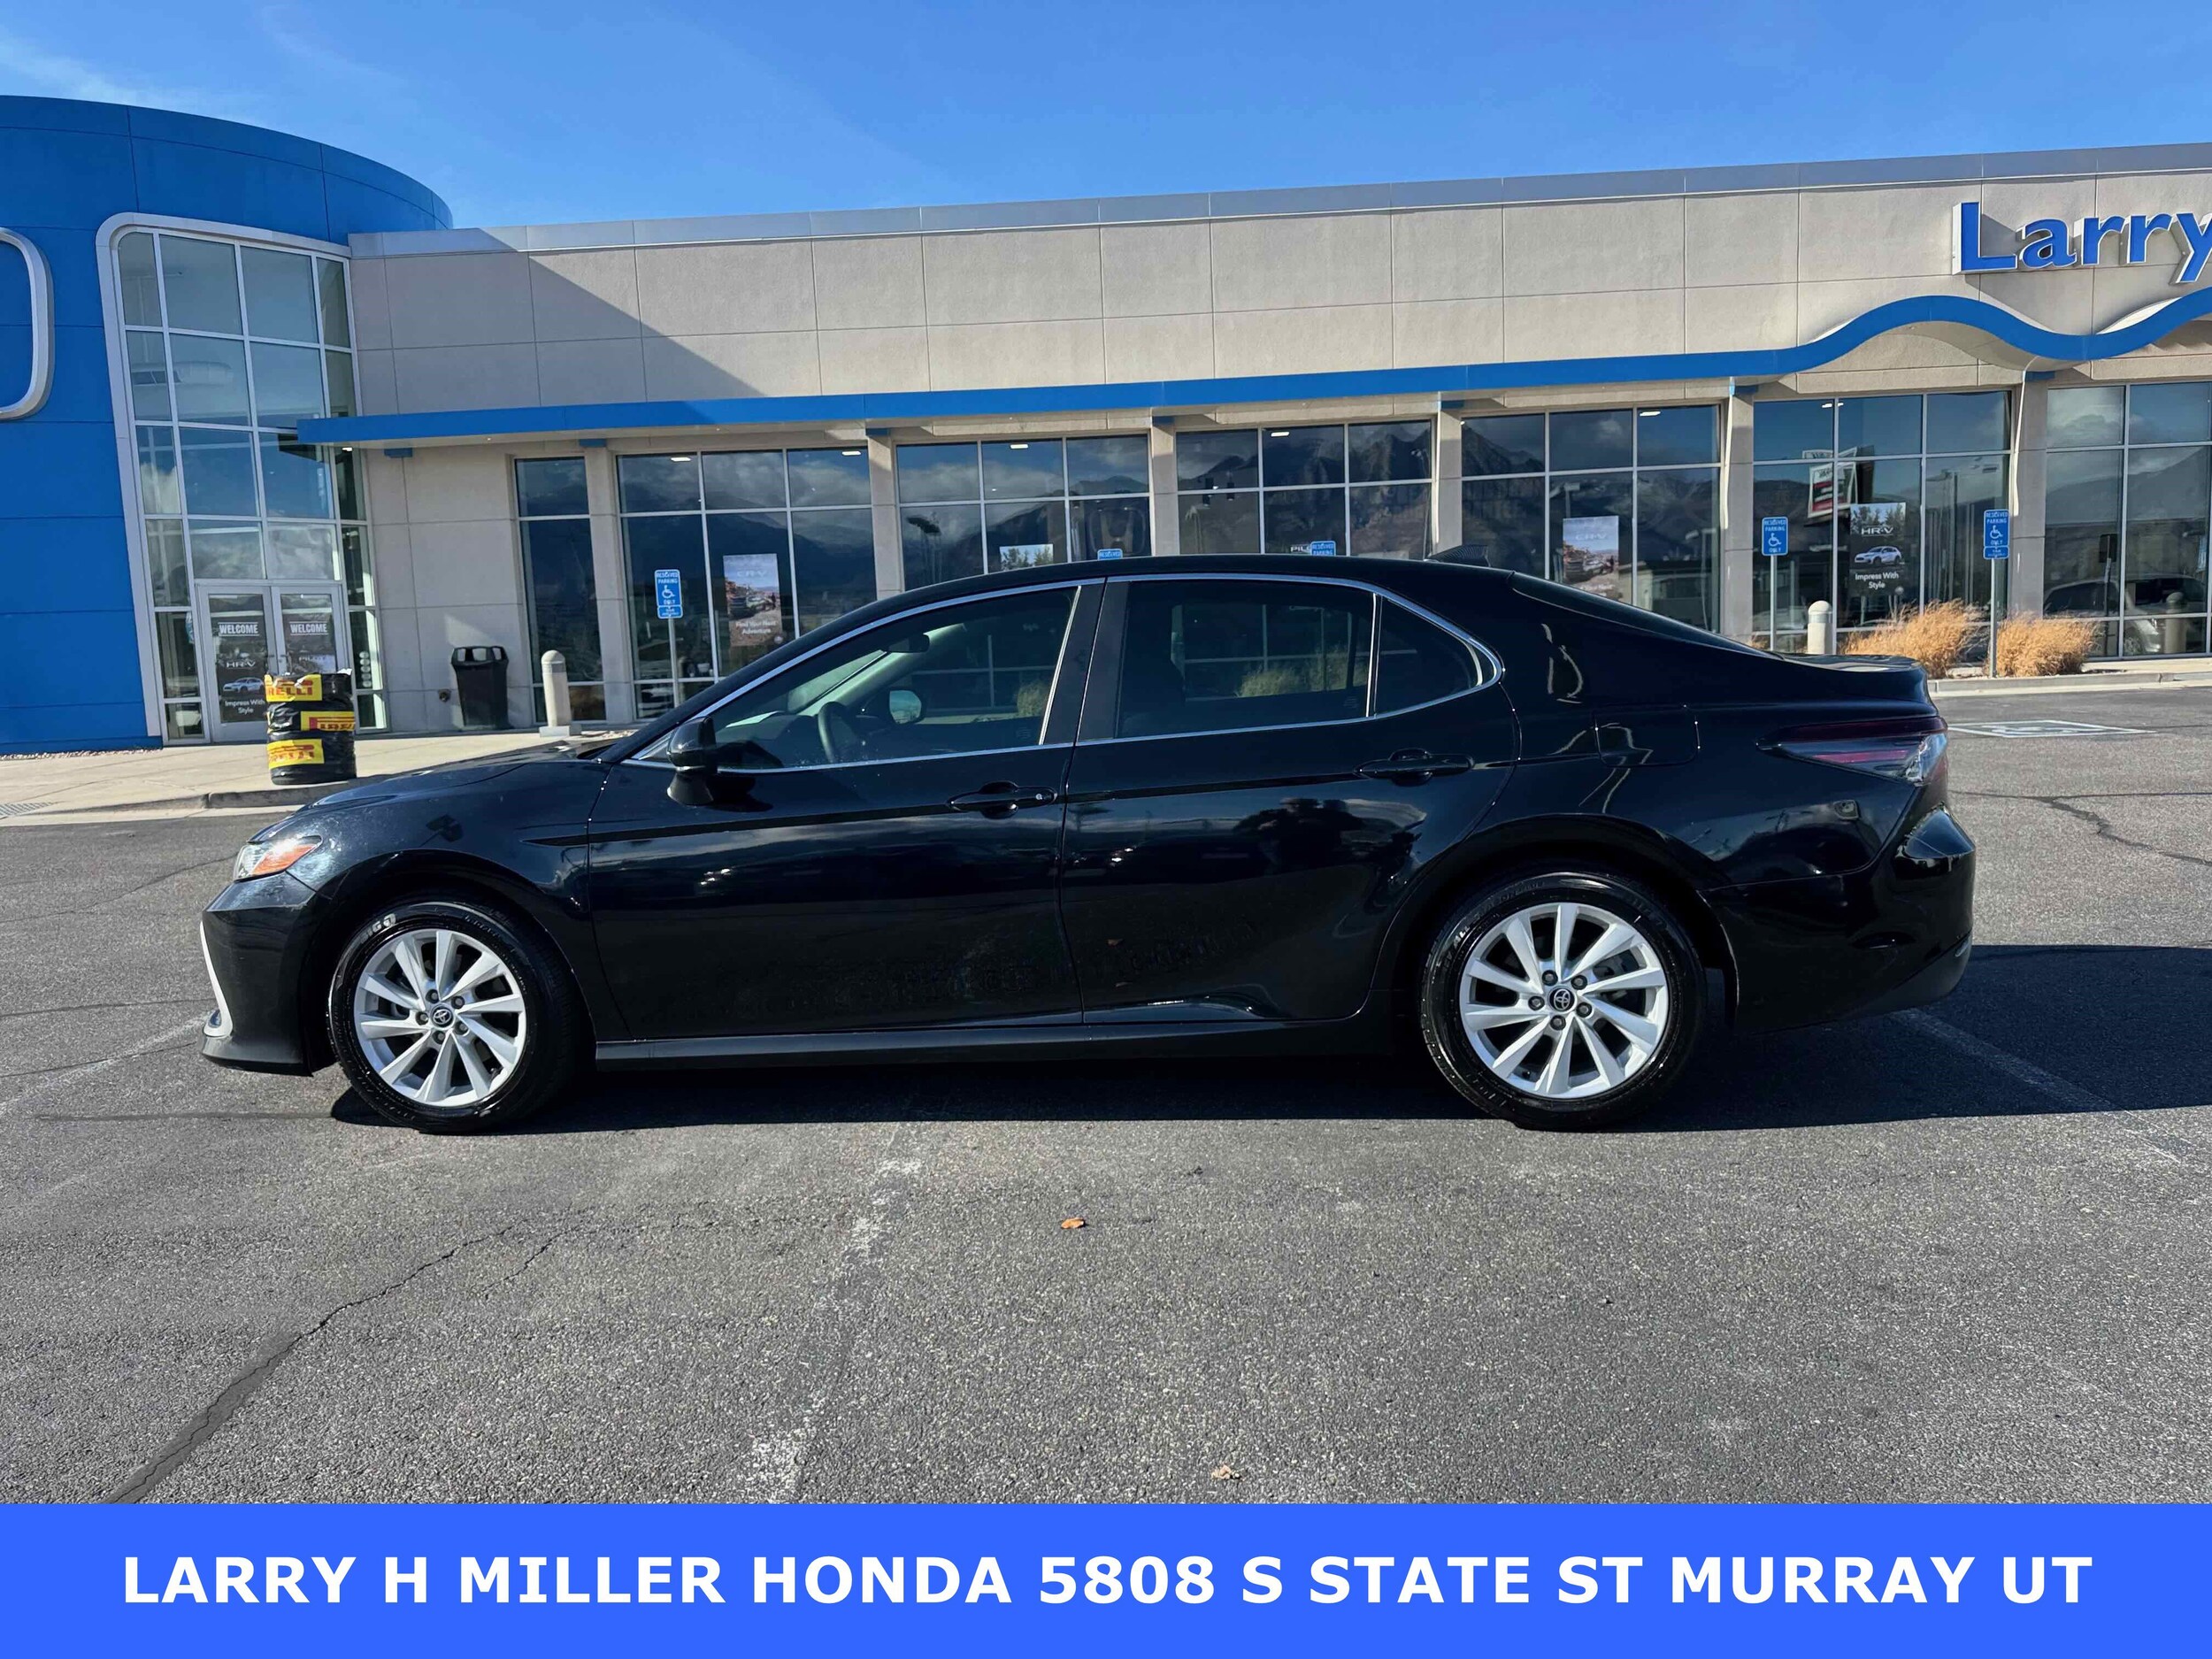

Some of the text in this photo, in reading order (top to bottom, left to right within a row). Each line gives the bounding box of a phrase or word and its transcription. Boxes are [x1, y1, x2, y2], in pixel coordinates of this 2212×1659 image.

[1954, 201, 2212, 283] Larry
[1855, 571, 1899, 581] Impress With
[1868, 580, 1886, 590] Style
[219, 624, 258, 634] WELCOME
[290, 623, 328, 634] WELCOME
[225, 699, 249, 708] Impress
[237, 707, 254, 716] Style
